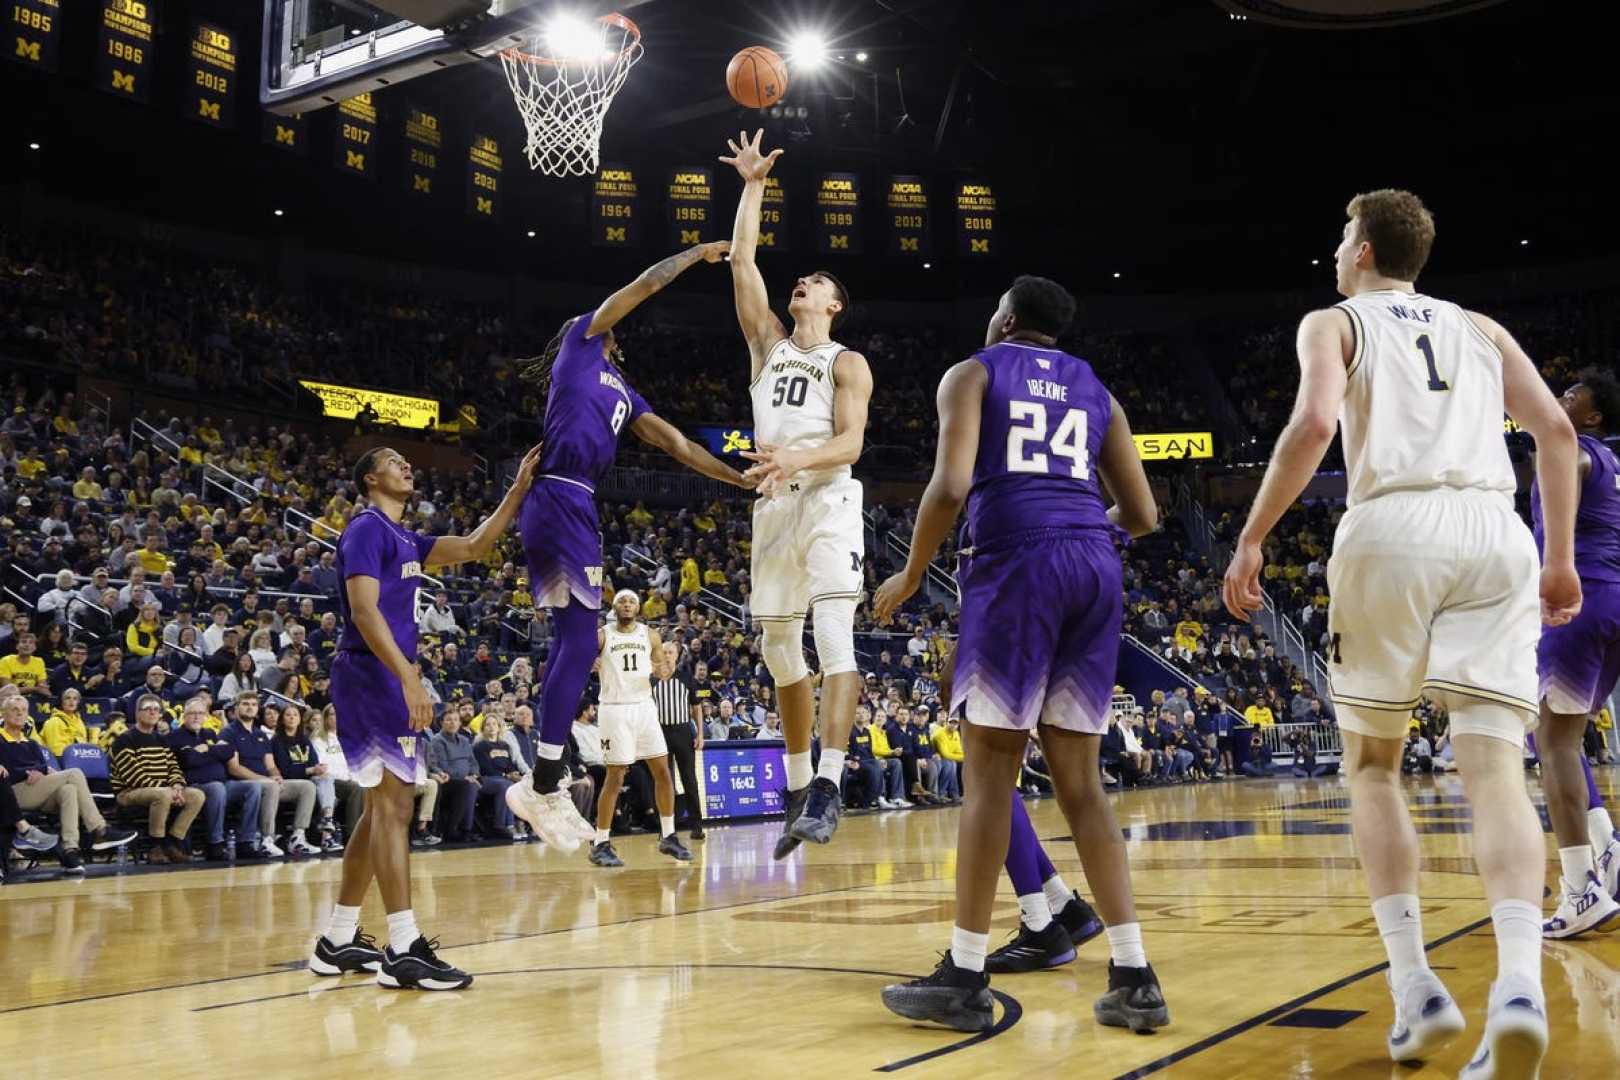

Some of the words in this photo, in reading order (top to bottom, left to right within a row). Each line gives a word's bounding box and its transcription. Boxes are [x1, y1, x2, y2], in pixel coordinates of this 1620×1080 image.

[14, 5, 52, 32] 1985
[16, 37, 41, 61] M
[107, 39, 144, 64] 1986
[112, 69, 135, 93] M
[195, 69, 227, 93] 2012
[199, 98, 221, 121] M
[275, 125, 294, 145] M
[343, 123, 371, 144] 2017
[346, 150, 365, 171] M
[474, 171, 497, 192] 2021
[601, 170, 632, 181] NCAA
[674, 174, 706, 185] NCAA
[414, 174, 431, 193] M
[595, 181, 617, 191] FINAL
[670, 185, 690, 194] FINAL
[692, 186, 711, 194] FOUR
[822, 180, 852, 191] NCAA
[892, 183, 922, 194] NCAA
[963, 185, 992, 196] NCAA
[818, 191, 839, 201] FINAL
[477, 196, 493, 215] M
[601, 204, 632, 217] 1964
[675, 207, 706, 221] 1965
[824, 213, 853, 226] 1989
[895, 215, 922, 228] 2013
[965, 217, 992, 230] 2018
[606, 227, 626, 241] M
[681, 230, 701, 244] M
[757, 231, 775, 246] M
[830, 235, 849, 249] M
[900, 237, 919, 251] M
[971, 238, 989, 252] M
[1416, 333, 1449, 391] 1
[772, 376, 809, 408] 50
[1027, 378, 1069, 402] IBEKWE
[370, 393, 384, 404] OF
[385, 395, 437, 412] MICHIGAN
[379, 407, 411, 419] UNION
[611, 400, 627, 436] 8
[1007, 399, 1090, 481] 24
[1142, 438, 1205, 454] SAN
[583, 566, 603, 587] W
[610, 642, 646, 653] MICHIGAN
[623, 653, 638, 672] 11
[36, 702, 51, 714] M
[85, 703, 101, 715] M
[397, 736, 417, 758] W
[600, 738, 611, 750] M
[709, 764, 719, 783] 8
[764, 762, 773, 780] 5
[730, 776, 756, 790] 16:42
